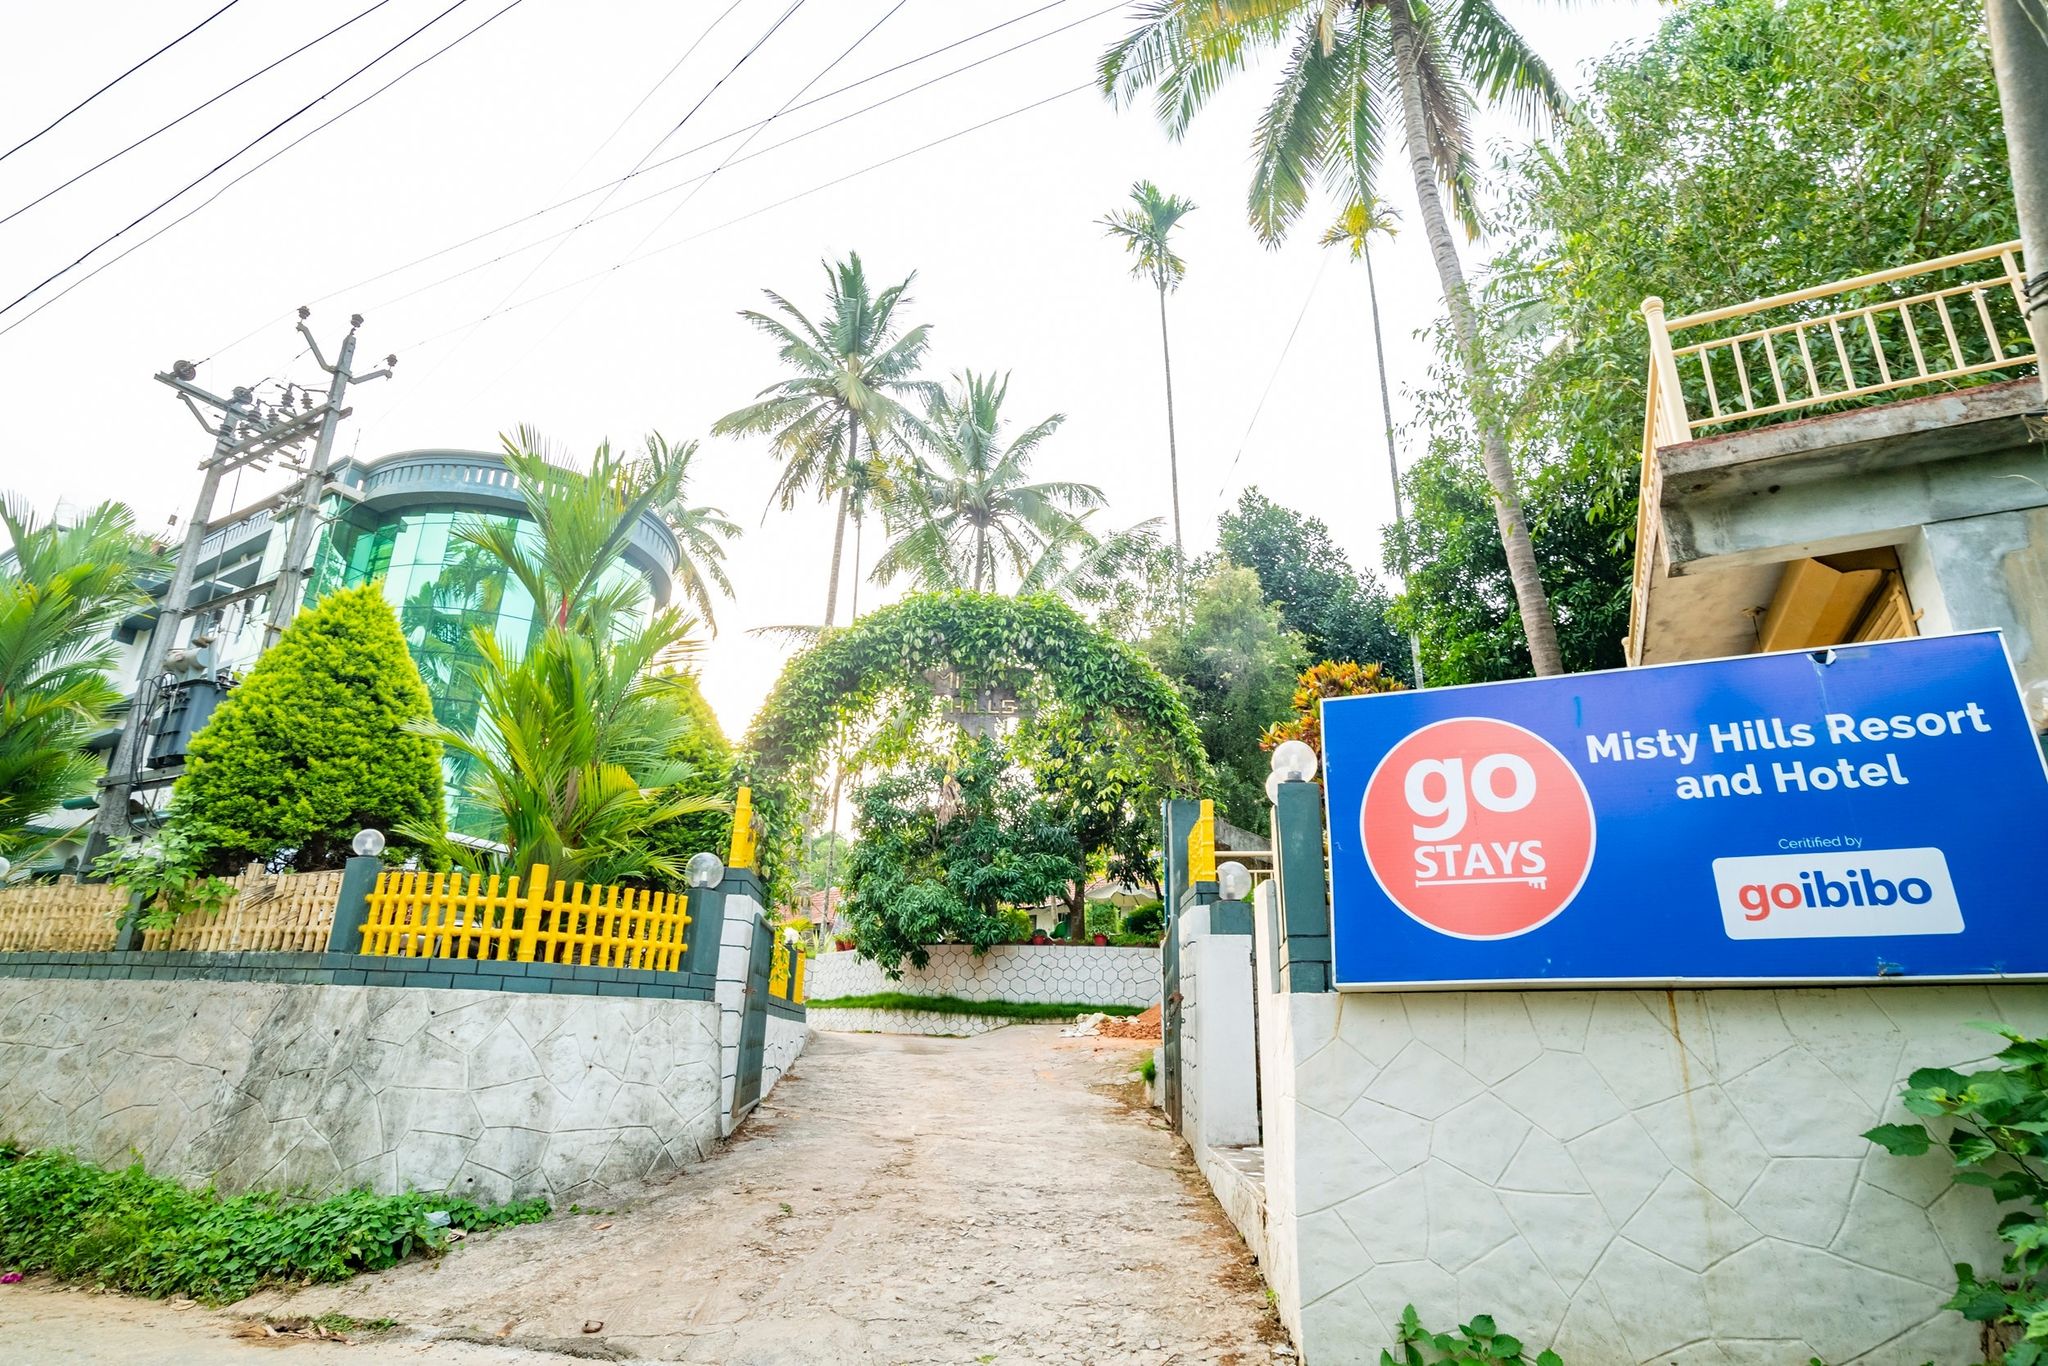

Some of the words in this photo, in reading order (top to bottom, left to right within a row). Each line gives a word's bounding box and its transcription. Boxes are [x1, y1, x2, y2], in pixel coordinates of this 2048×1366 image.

[1586, 729, 1698, 765] Misty
[1709, 718, 1816, 753] Hills
[1825, 702, 1992, 745] Resort
[1404, 753, 1536, 841] go
[1676, 764, 1761, 800] and
[1772, 753, 1909, 793] Hotel
[1414, 840, 1546, 878] STAYS
[1845, 835, 1863, 849] by
[1738, 868, 1933, 922] goibibo
